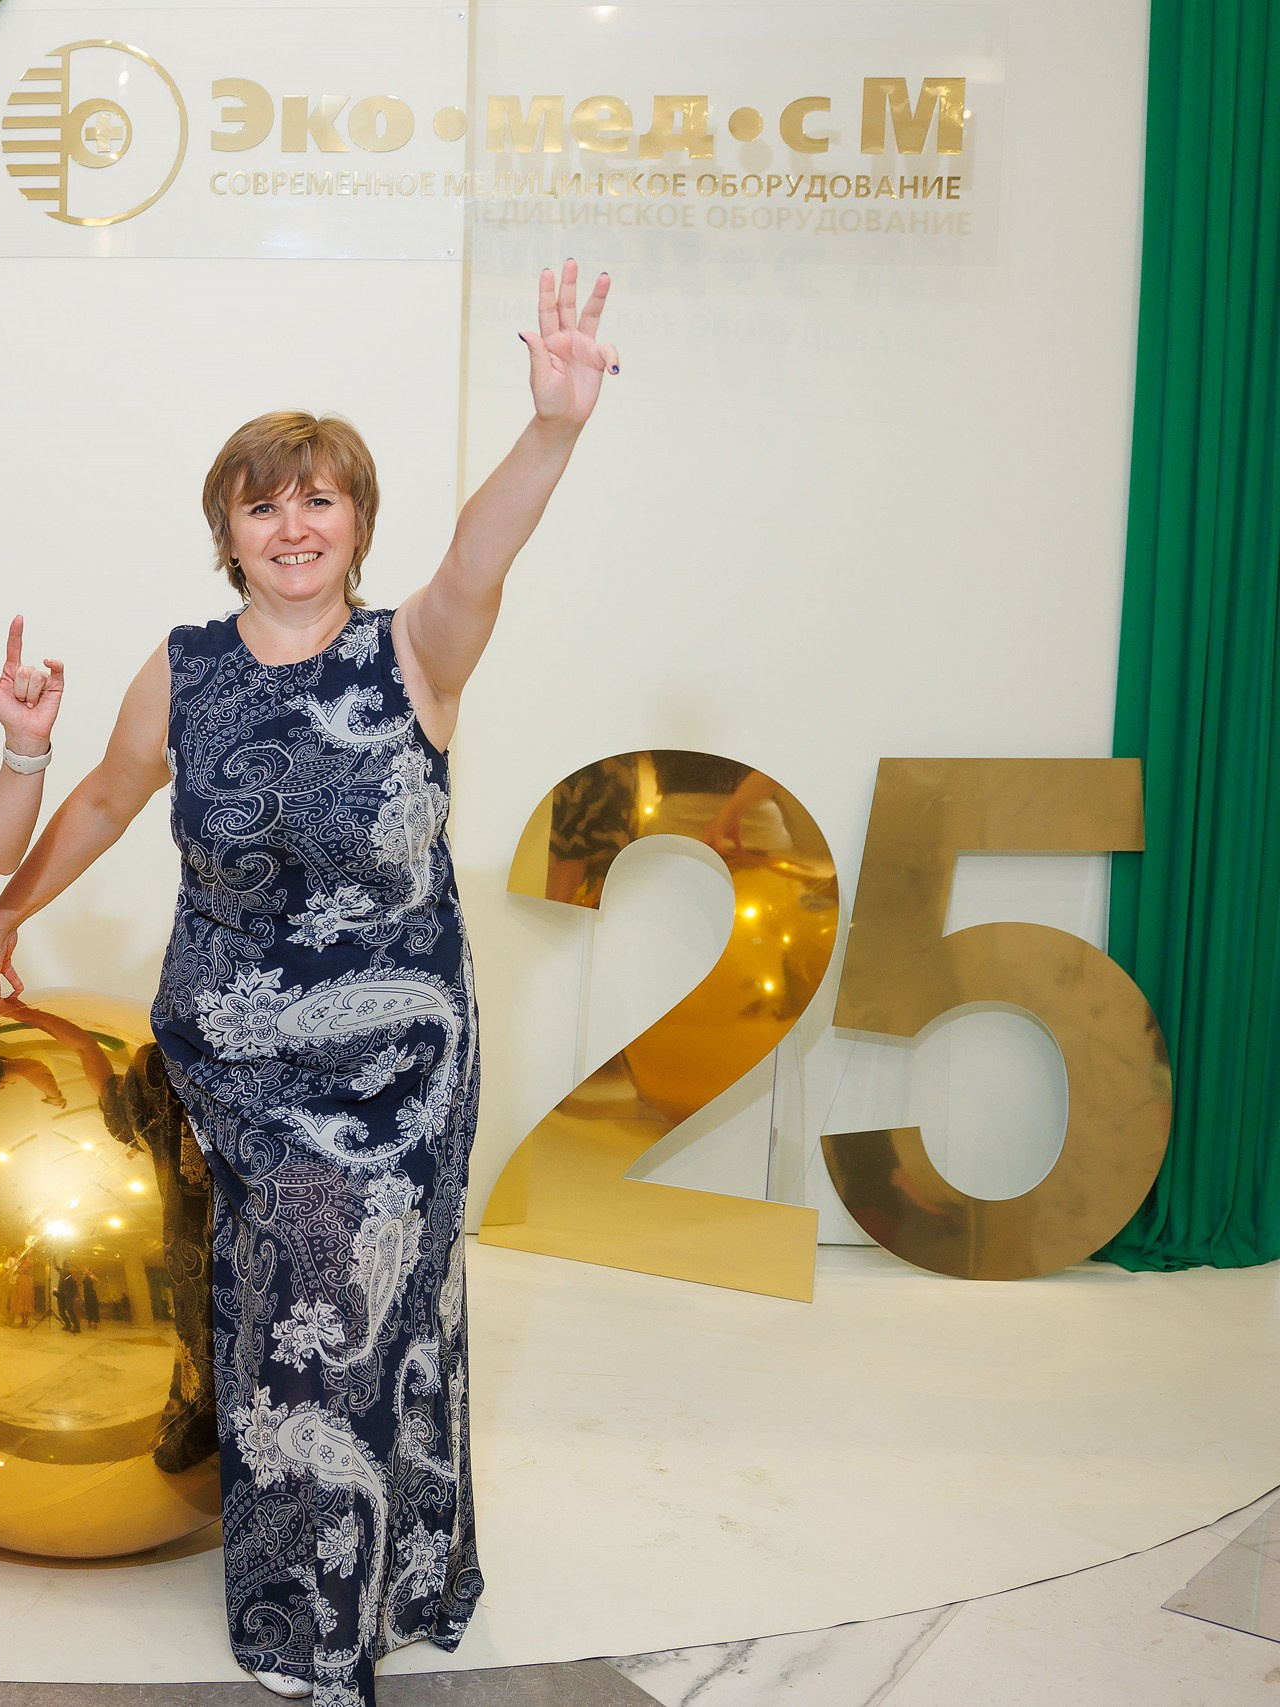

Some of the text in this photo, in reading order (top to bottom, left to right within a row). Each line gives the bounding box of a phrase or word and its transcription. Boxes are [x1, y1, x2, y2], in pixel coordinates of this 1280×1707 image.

[209, 170, 961, 203] СОВРЕМЕННОЕ МЕДИЦИНСКОЕ ОБОРУДОВАНИЕ
[478, 749, 1172, 1303] 25
